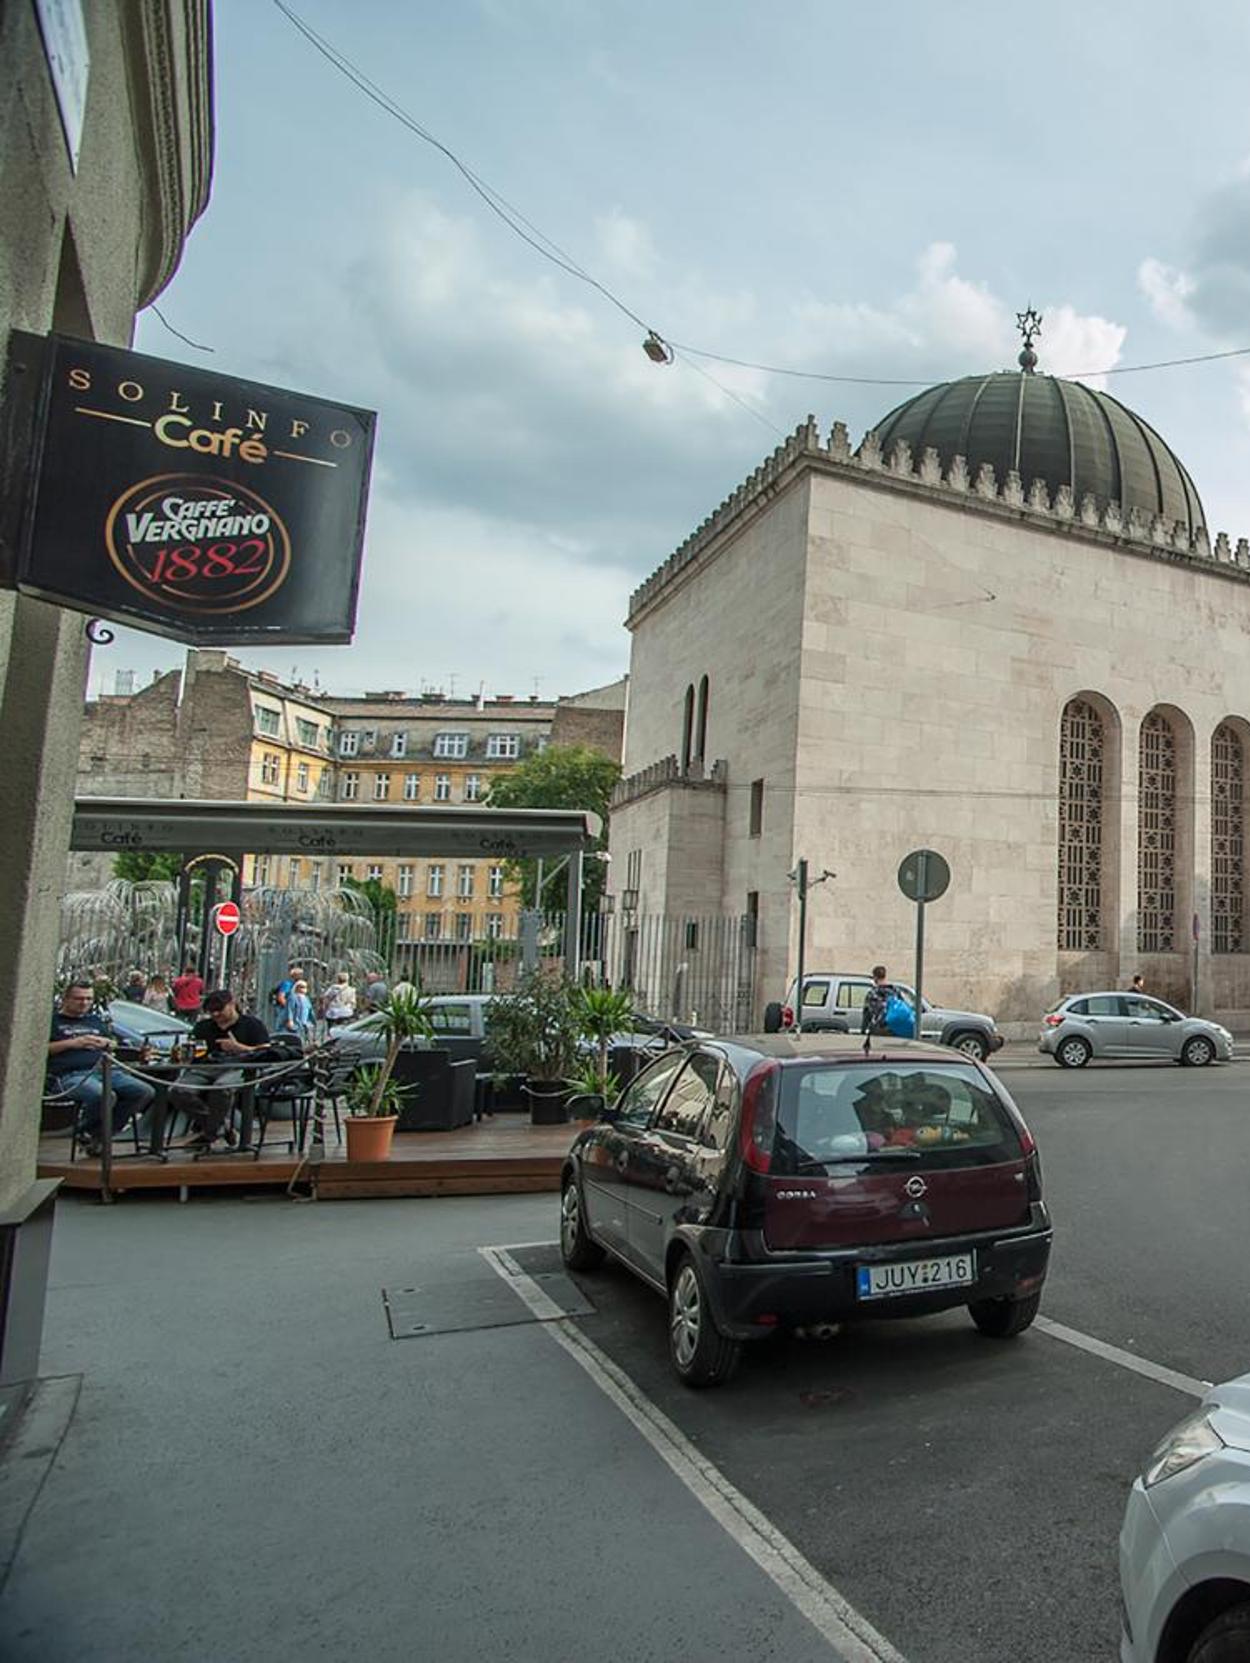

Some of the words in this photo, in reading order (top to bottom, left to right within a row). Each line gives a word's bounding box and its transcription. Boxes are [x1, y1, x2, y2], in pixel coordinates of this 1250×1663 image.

[68, 368, 351, 449] SOLINFO
[154, 413, 268, 465] Café
[125, 512, 271, 543] VERGNANO
[151, 539, 267, 583] 1882
